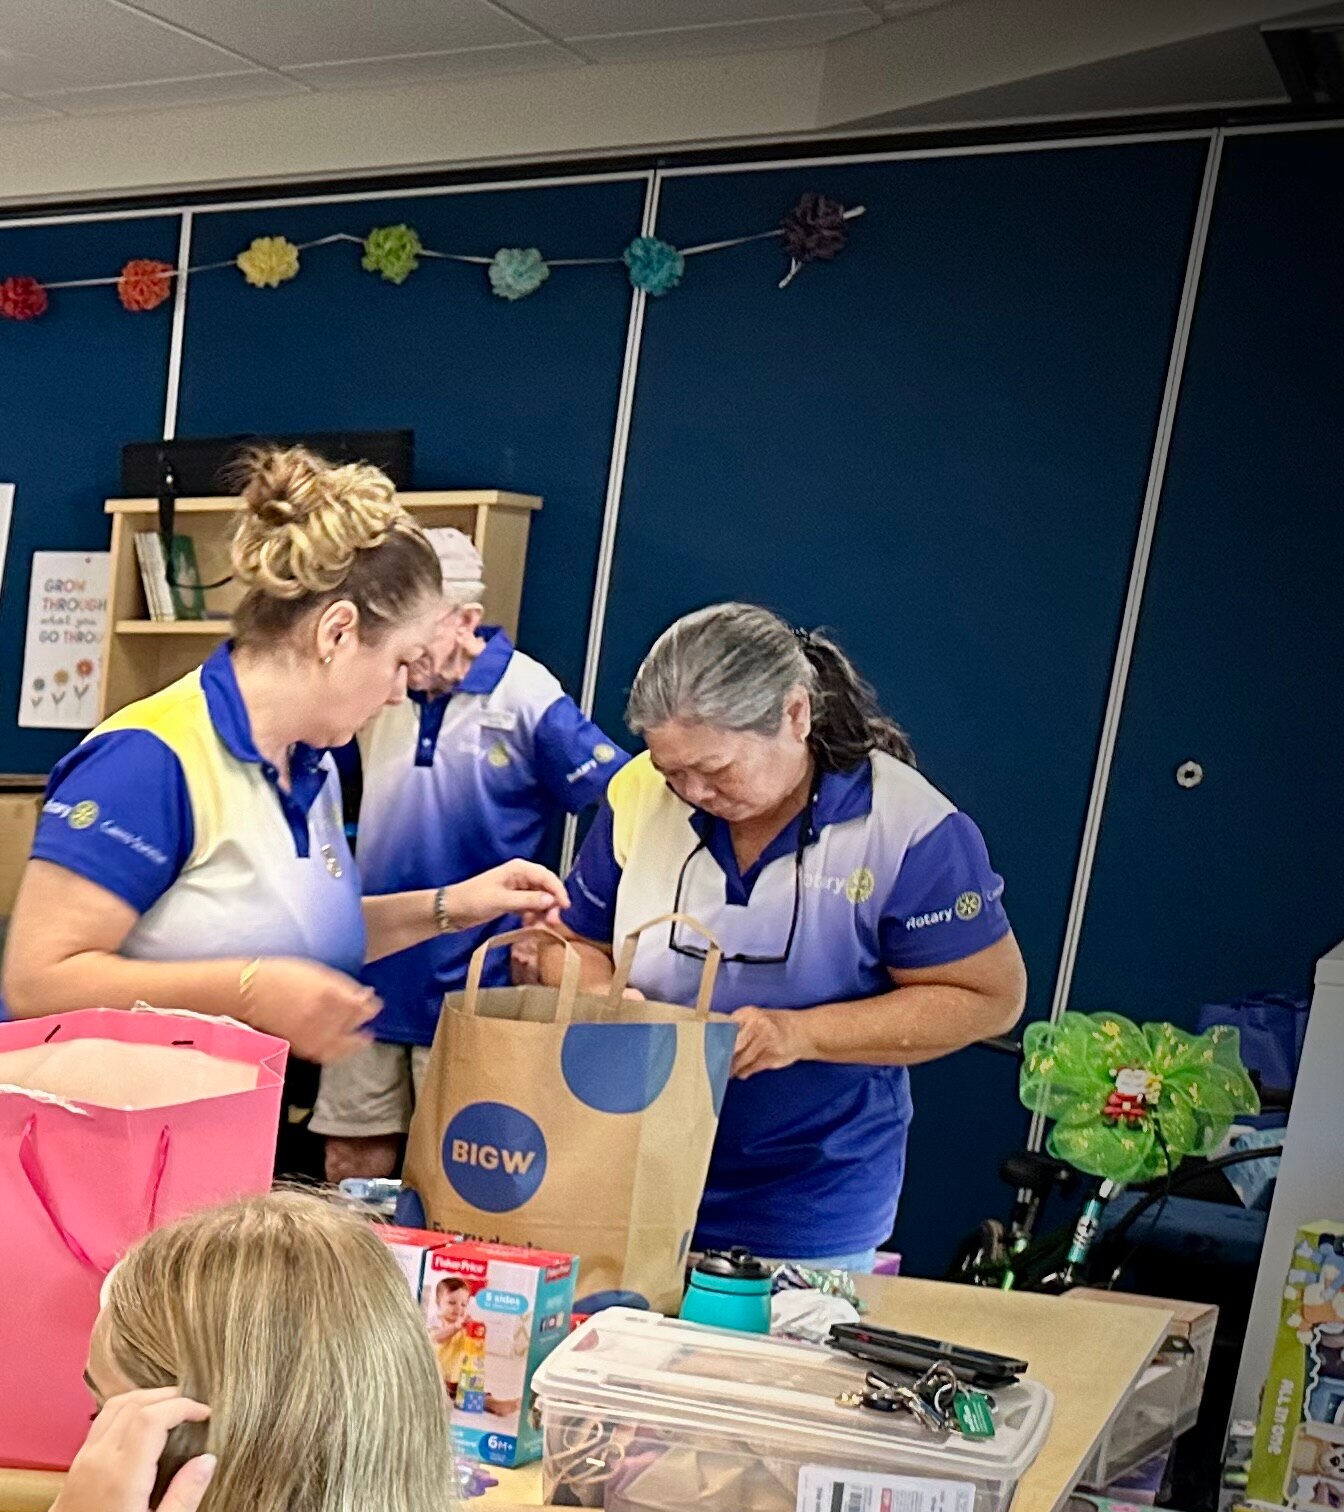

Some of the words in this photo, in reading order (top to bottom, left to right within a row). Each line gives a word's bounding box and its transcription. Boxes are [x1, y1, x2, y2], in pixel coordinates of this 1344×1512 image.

[44, 578, 86, 593] GROW
[43, 597, 108, 612] THROUGH
[38, 630, 59, 643] GO
[905, 907, 953, 931] Rotary
